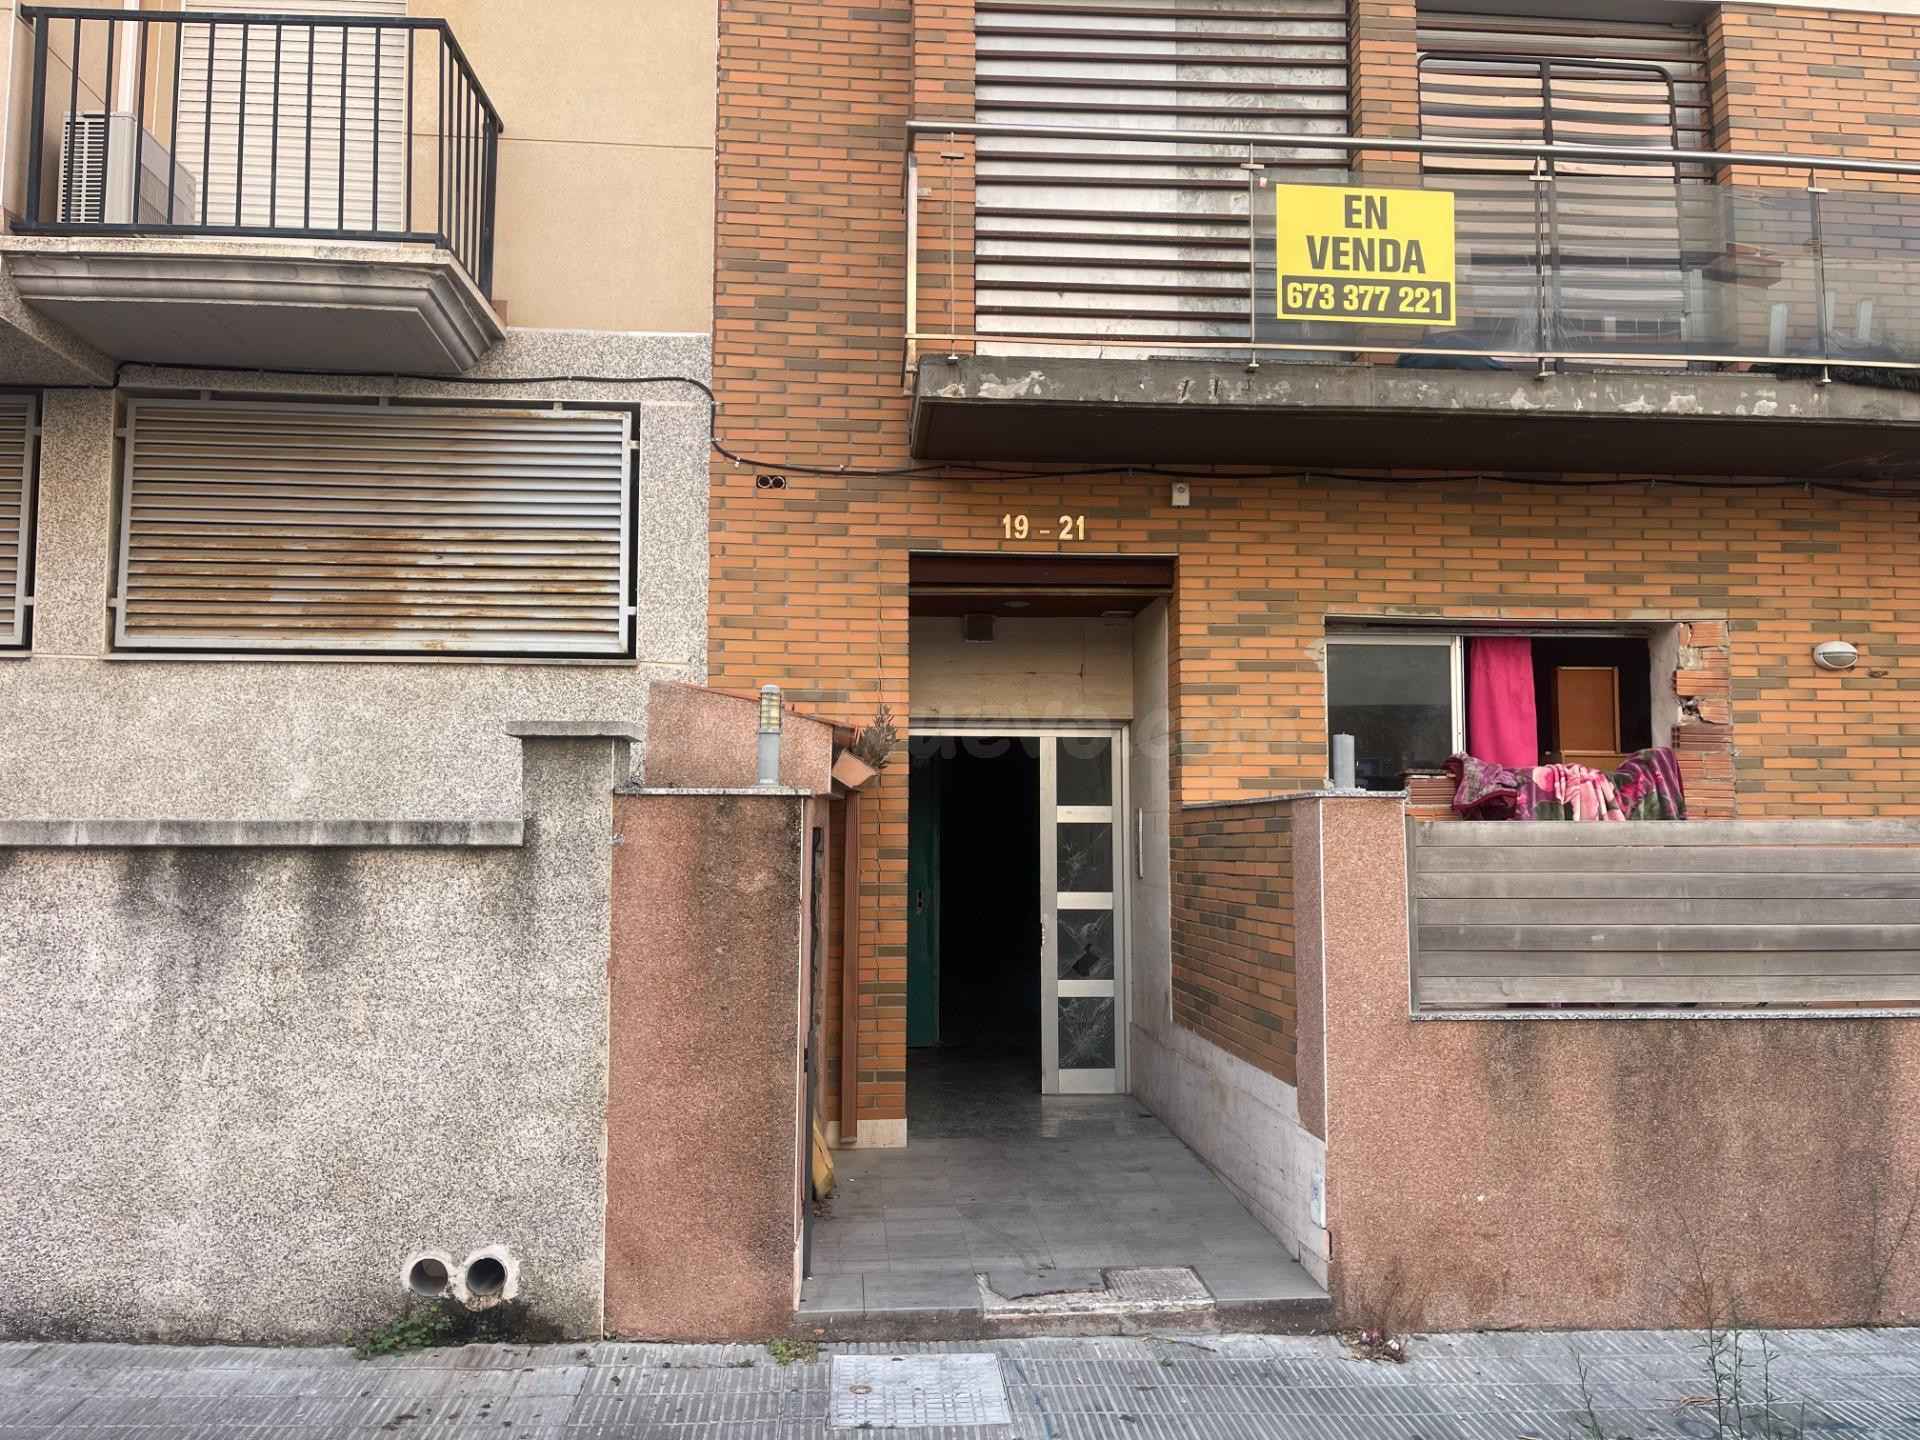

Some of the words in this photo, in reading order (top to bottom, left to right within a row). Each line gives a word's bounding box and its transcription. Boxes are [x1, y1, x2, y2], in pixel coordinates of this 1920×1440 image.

[1344, 194, 1388, 230] EN
[1306, 235, 1426, 274] VENDA
[1287, 282, 1335, 309] 673
[1343, 284, 1391, 312] 377
[1398, 286, 1443, 314] 221
[1003, 513, 1029, 539] 19
[1059, 515, 1085, 540] 21
